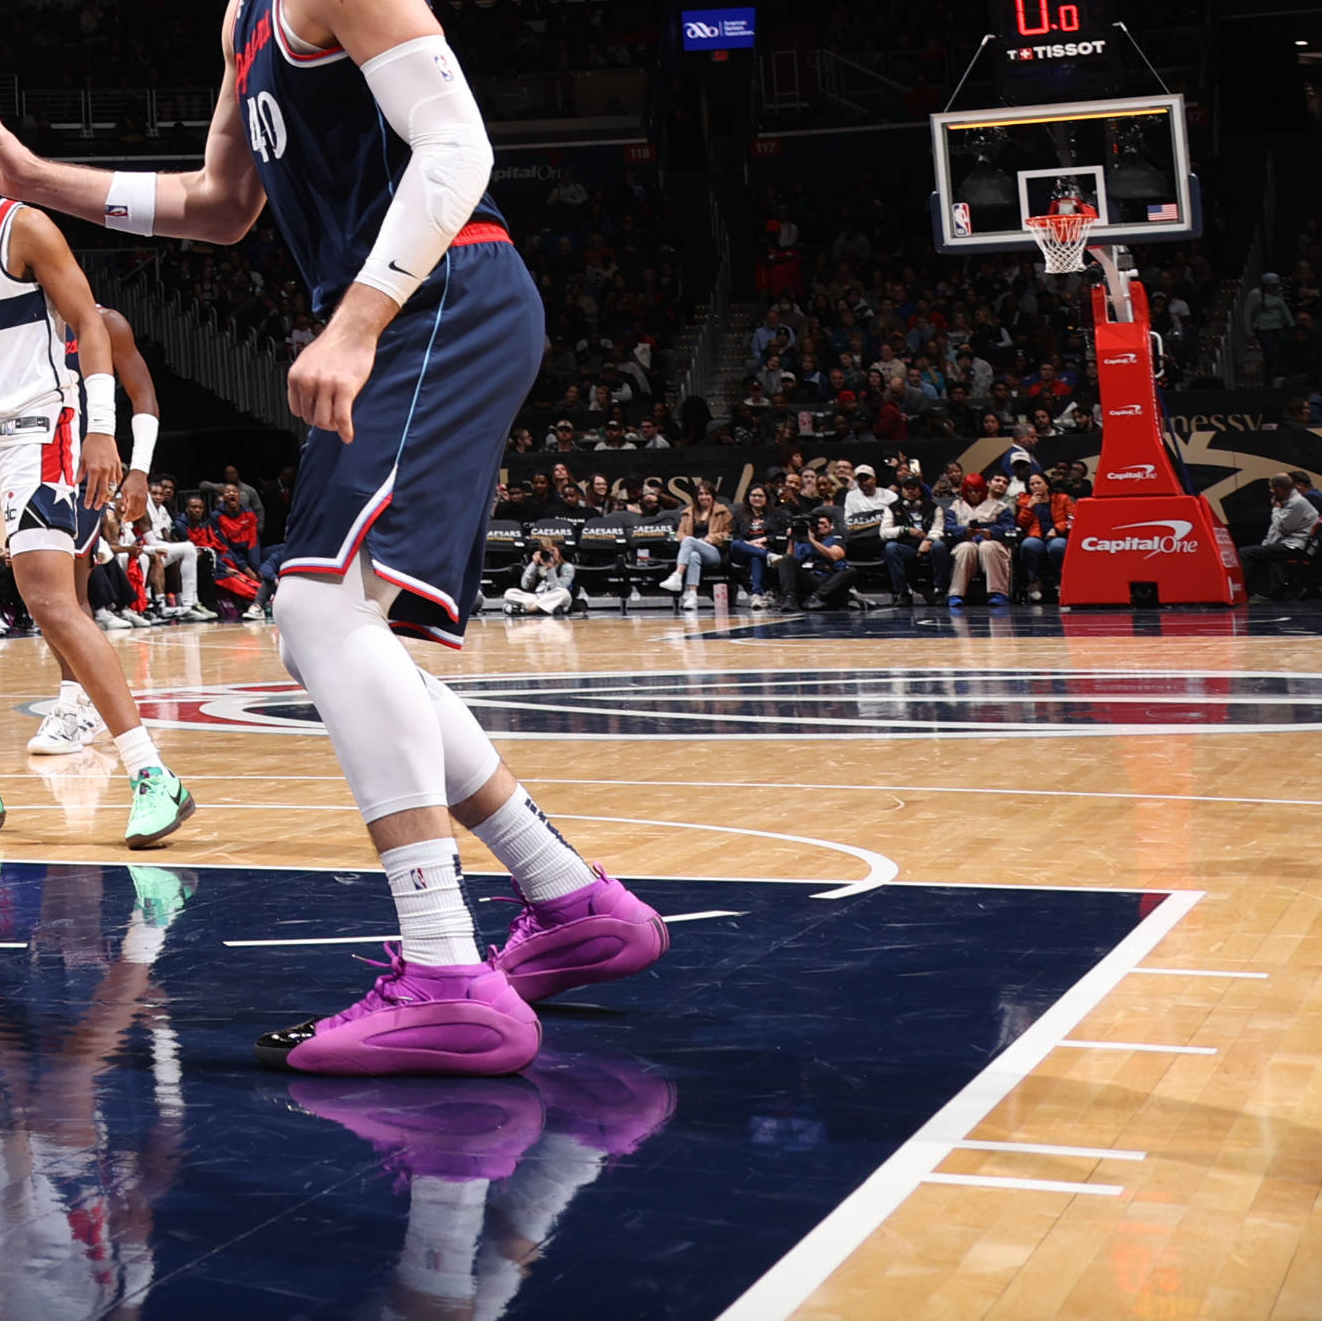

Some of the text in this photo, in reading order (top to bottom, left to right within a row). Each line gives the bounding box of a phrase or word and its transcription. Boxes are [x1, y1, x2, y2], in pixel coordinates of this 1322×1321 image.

[1033, 39, 1107, 60] TISSOT
[246, 91, 288, 163] 40
[531, 528, 573, 537] CAESARS
[582, 527, 624, 536] CAESARS
